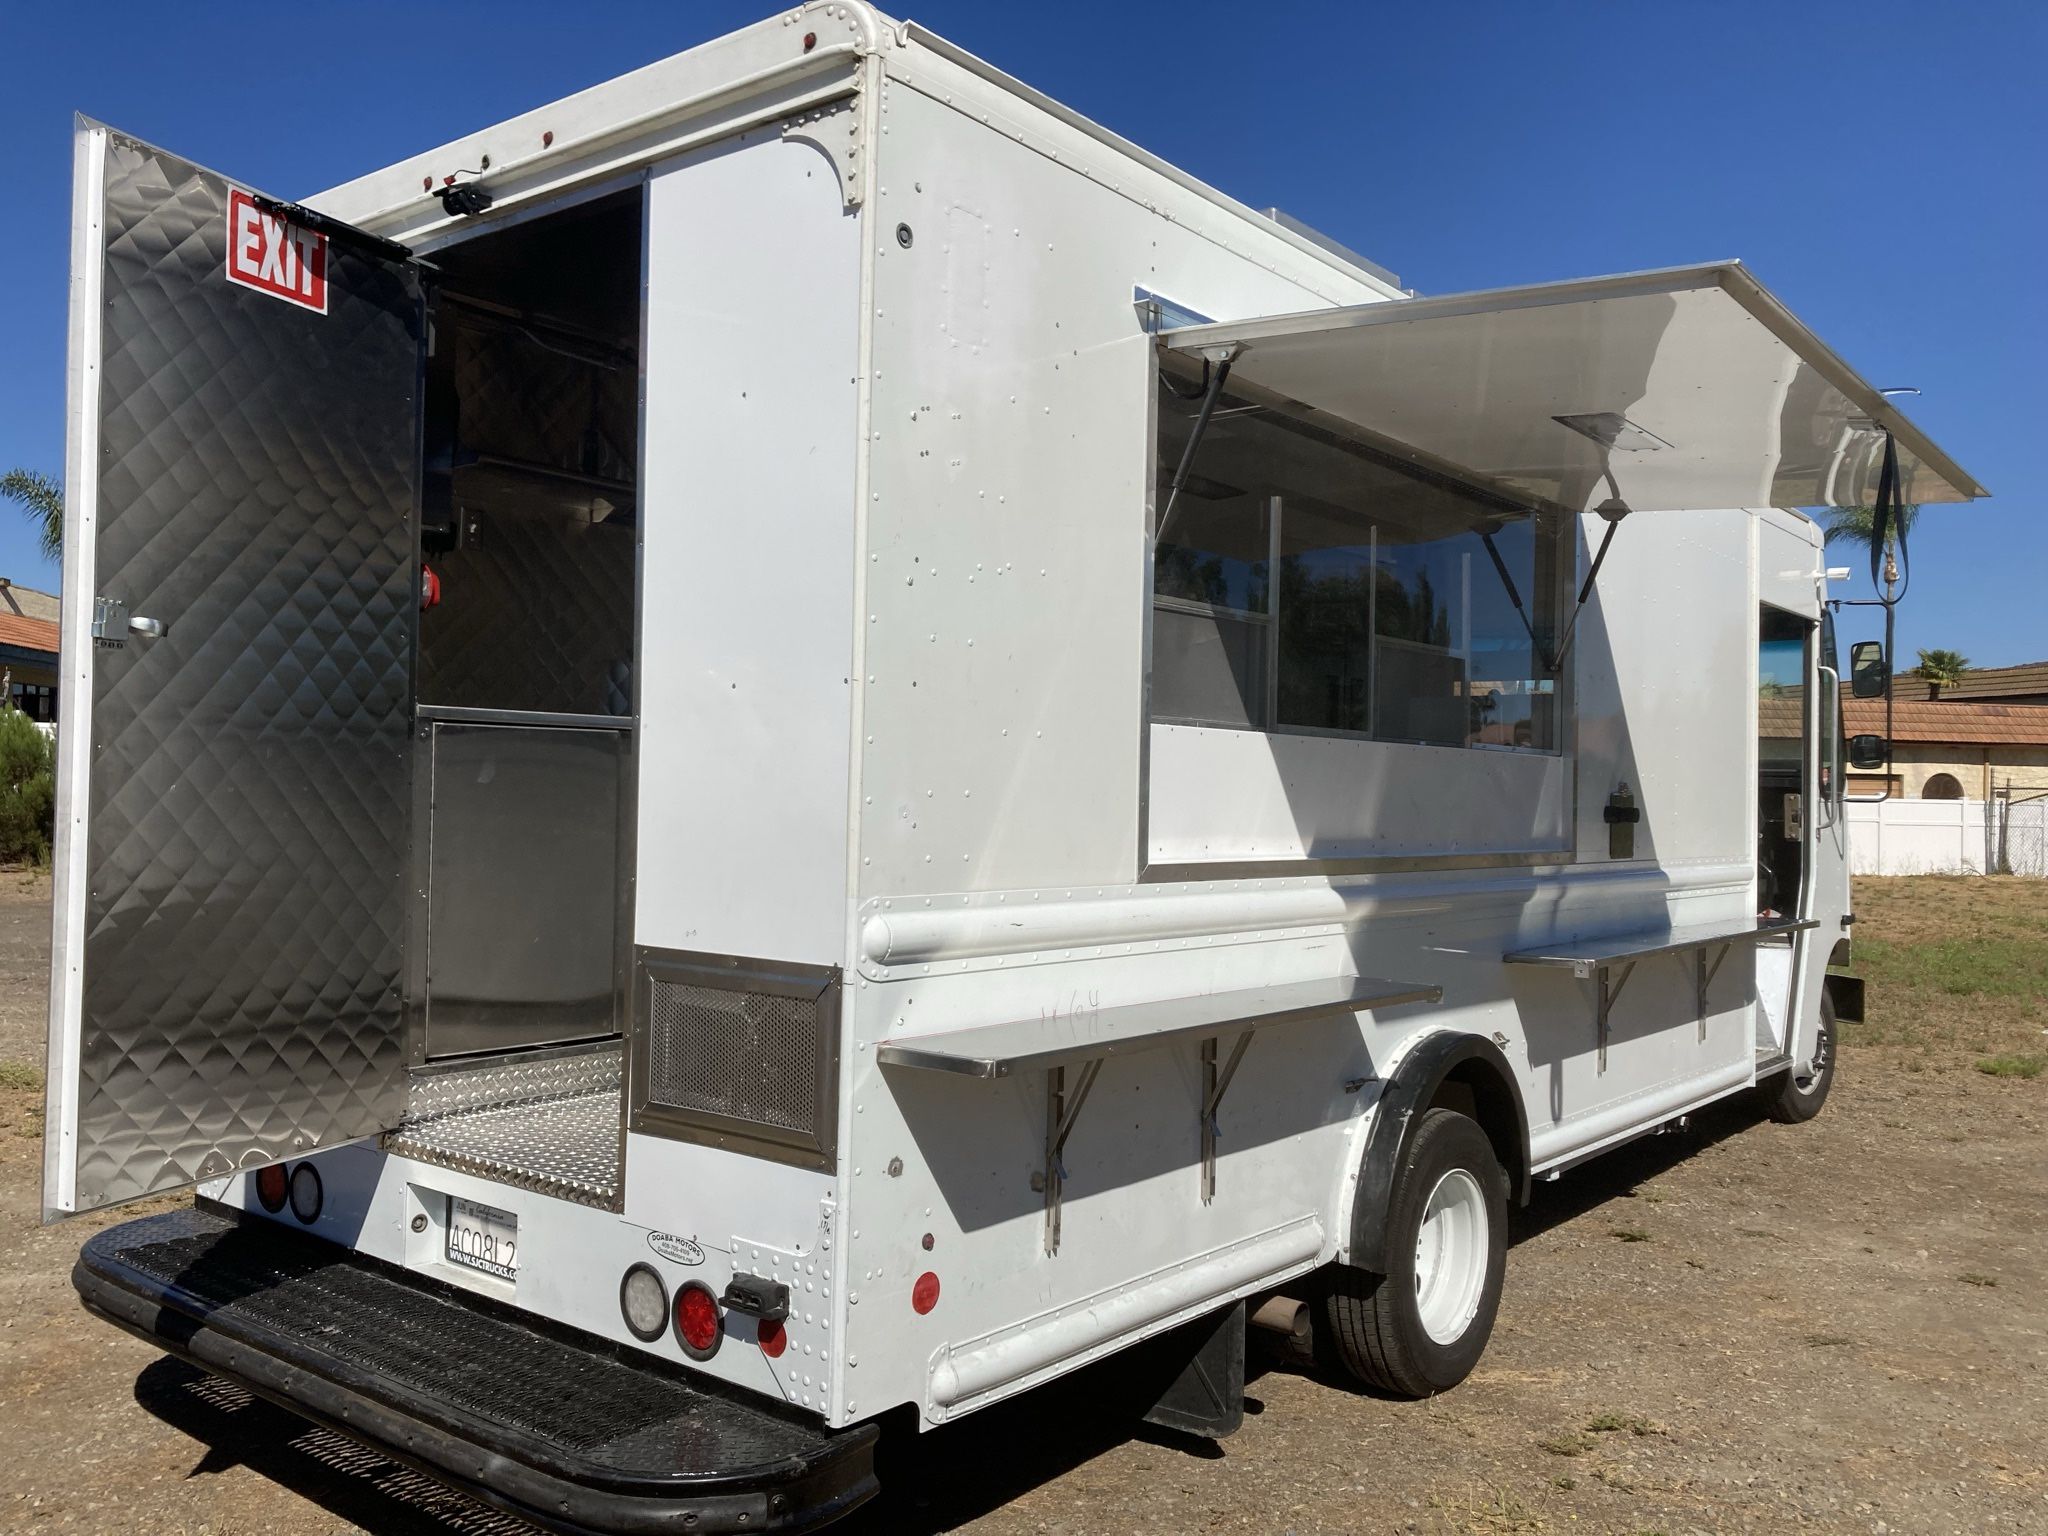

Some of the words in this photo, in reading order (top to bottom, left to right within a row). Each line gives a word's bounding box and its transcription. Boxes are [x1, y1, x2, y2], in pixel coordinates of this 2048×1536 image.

[237, 203, 319, 296] EXIT
[652, 1234, 673, 1242] DOABA
[676, 1237, 701, 1257] MOTORS
